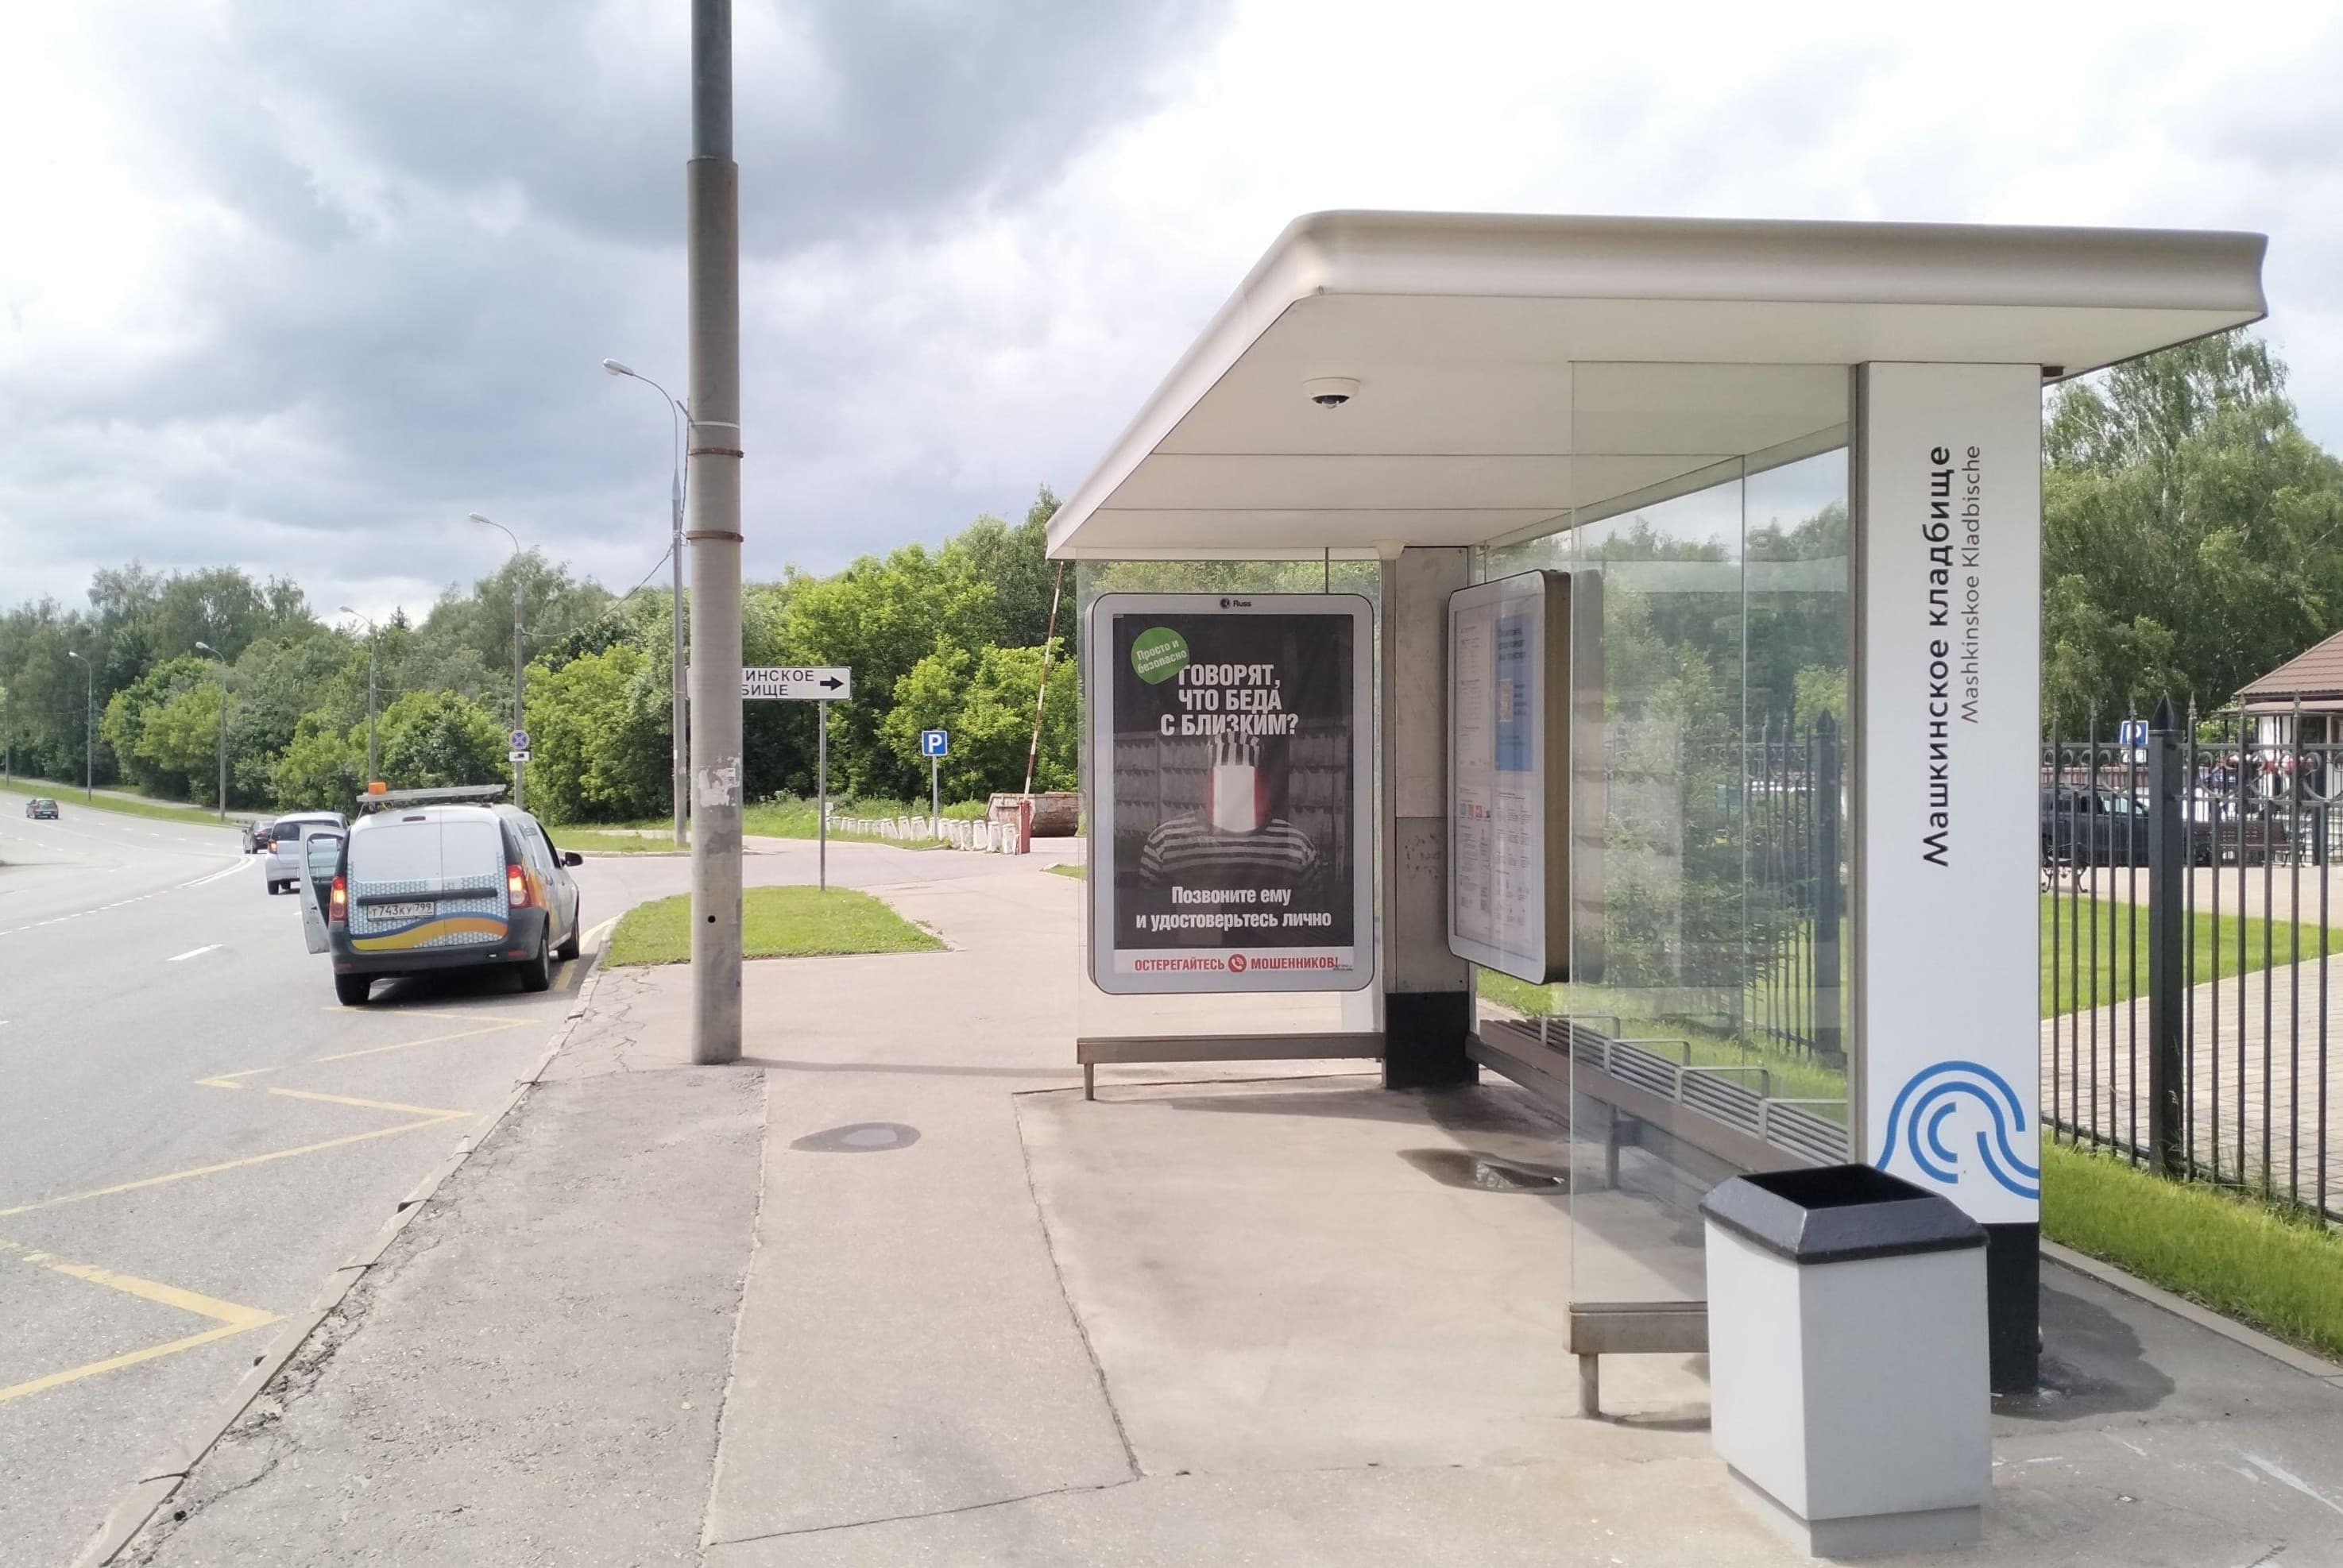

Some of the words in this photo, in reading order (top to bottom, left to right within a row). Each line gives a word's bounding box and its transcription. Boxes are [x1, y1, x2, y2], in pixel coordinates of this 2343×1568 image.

[1961, 445, 1981, 567] Kladbische
[1921, 446, 1954, 627] кладбище
[1136, 644, 1172, 661] Просто
[1173, 639, 1180, 648] и
[1960, 575, 1980, 724] Mashkinskoe
[1137, 649, 1188, 674] безопасно
[745, 670, 814, 682] ИНСКОЕ
[1177, 663, 1281, 689] ГОВОРЯТ,
[741, 684, 789, 698] БИЩЕ
[1178, 689, 1219, 711] ЧТО
[1226, 689, 1282, 714] БЕДА
[1160, 713, 1175, 736] С
[1181, 713, 1299, 736] БЛИЗКИМ?
[928, 734, 942, 753] P
[1922, 638, 1950, 867] Машкинское
[1171, 886, 1256, 904] Позвоните
[1260, 889, 1292, 906] ему
[1136, 915, 1146, 929] и
[1150, 913, 1278, 932] удостоверьтесь
[1282, 912, 1332, 927] лично
[1135, 958, 1224, 971] ОСТЕРЕГАЙТЕСЬ
[1251, 956, 1338, 969] МОШЕННИКОВ!
